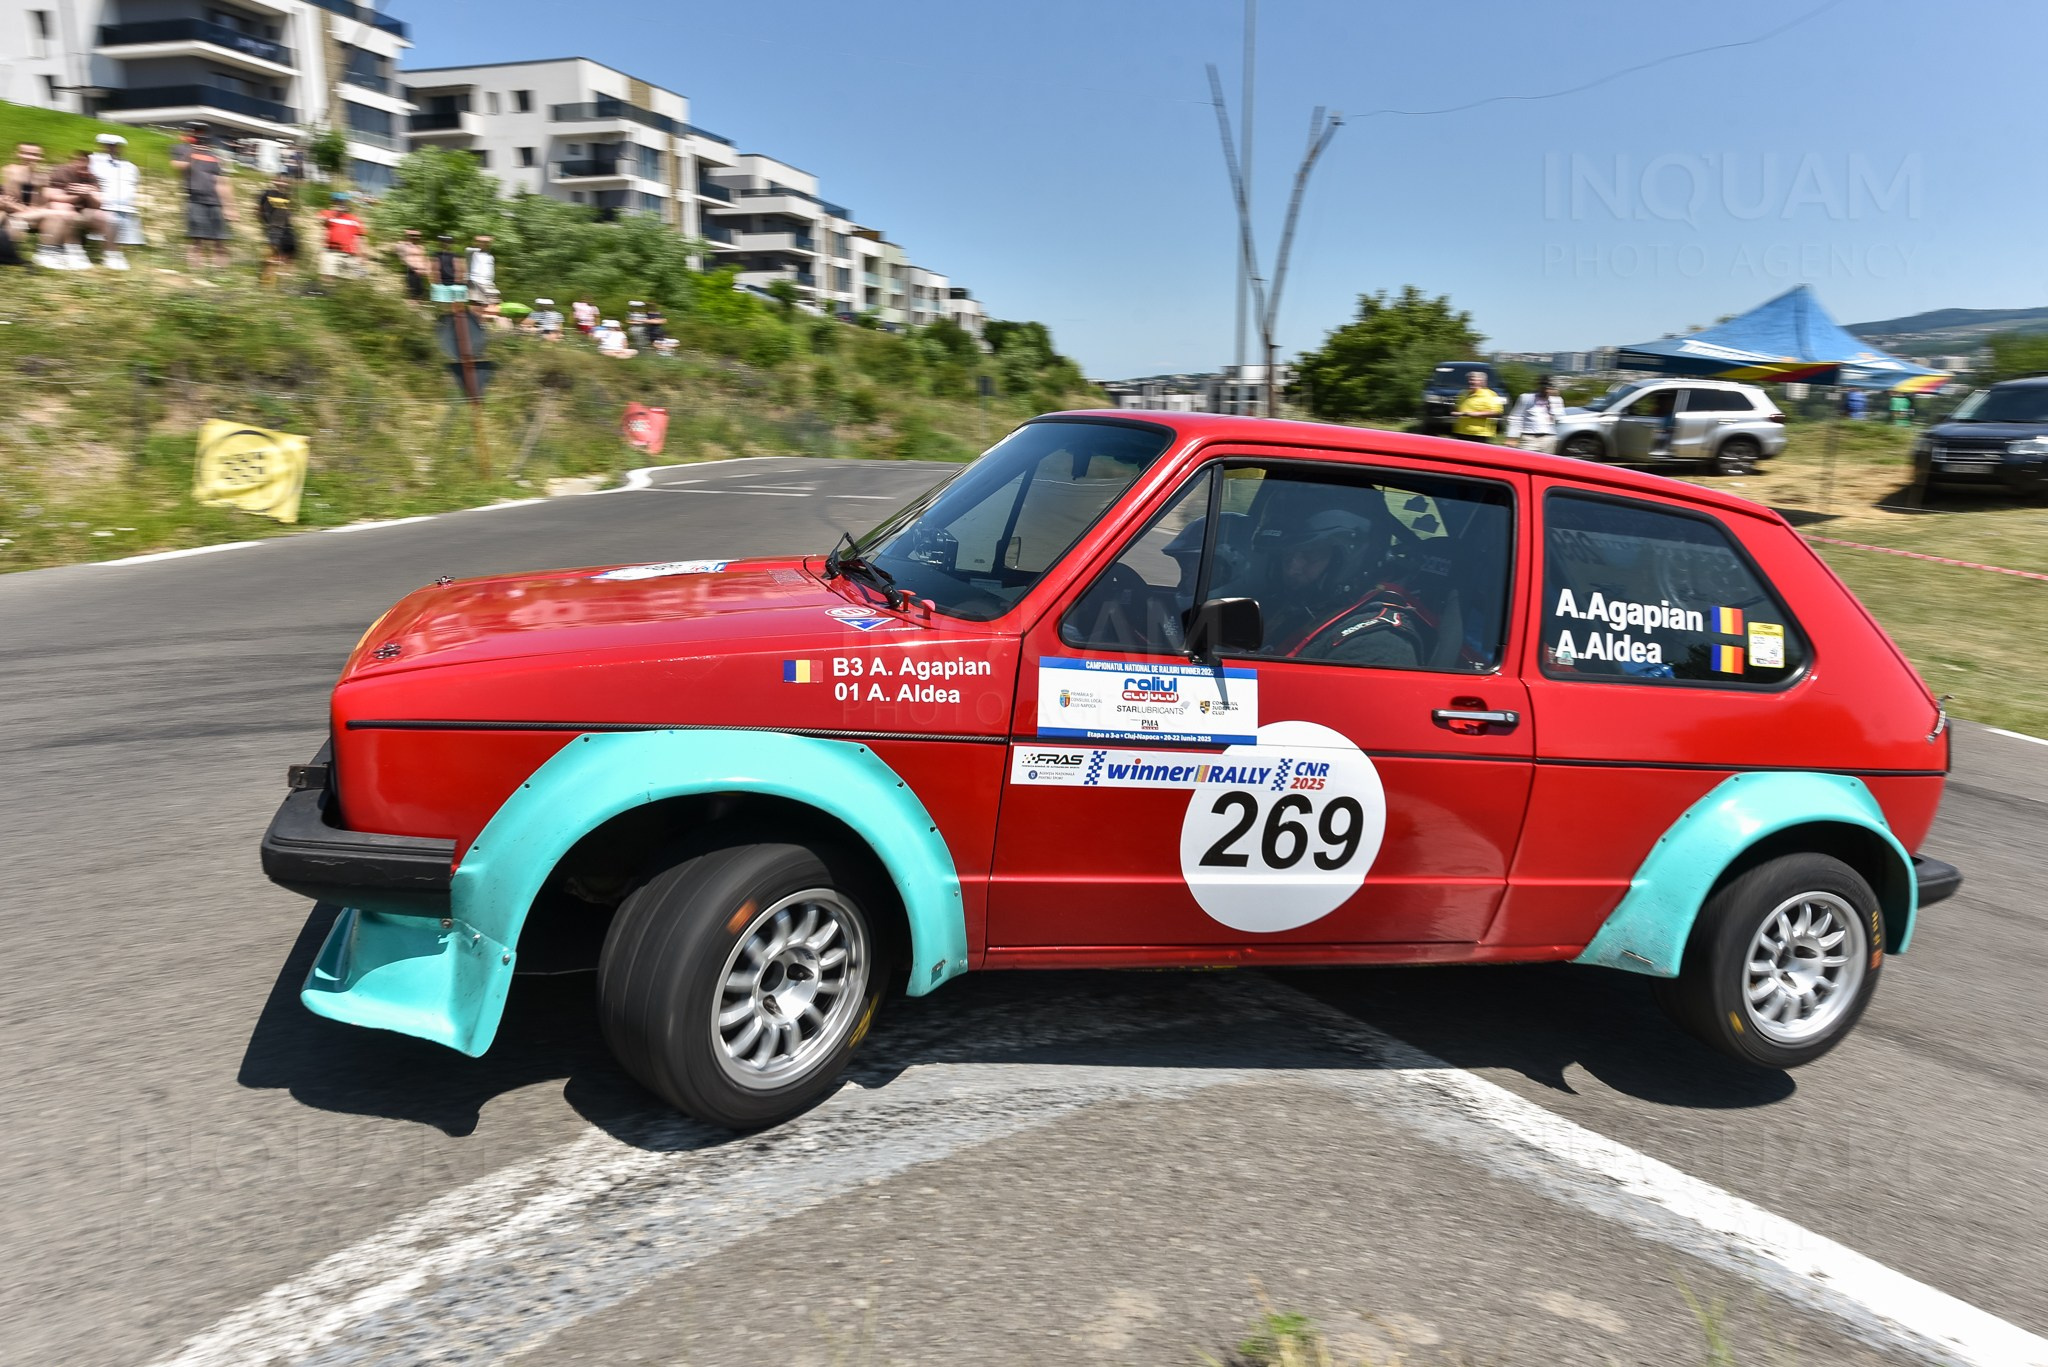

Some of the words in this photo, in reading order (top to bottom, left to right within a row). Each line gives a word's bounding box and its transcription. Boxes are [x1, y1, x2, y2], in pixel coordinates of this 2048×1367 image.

[832, 657, 864, 677] B3
[869, 658, 893, 676] A.
[899, 656, 991, 680] Agapian
[1085, 660, 1123, 671] CAMPIONATUL
[1151, 665, 1159, 674] DE
[1180, 666, 1200, 675] WINNER
[834, 682, 860, 701] 01
[867, 684, 891, 702] A.
[896, 684, 961, 703] Aldea
[1087, 731, 1105, 739] Etapa
[1035, 753, 1084, 766] FRAS
[1107, 758, 1195, 782] winner
[1208, 765, 1272, 785] RALLY
[1294, 761, 1330, 777] CNR
[1290, 777, 1326, 790] 2025
[1199, 790, 1364, 871] 269
